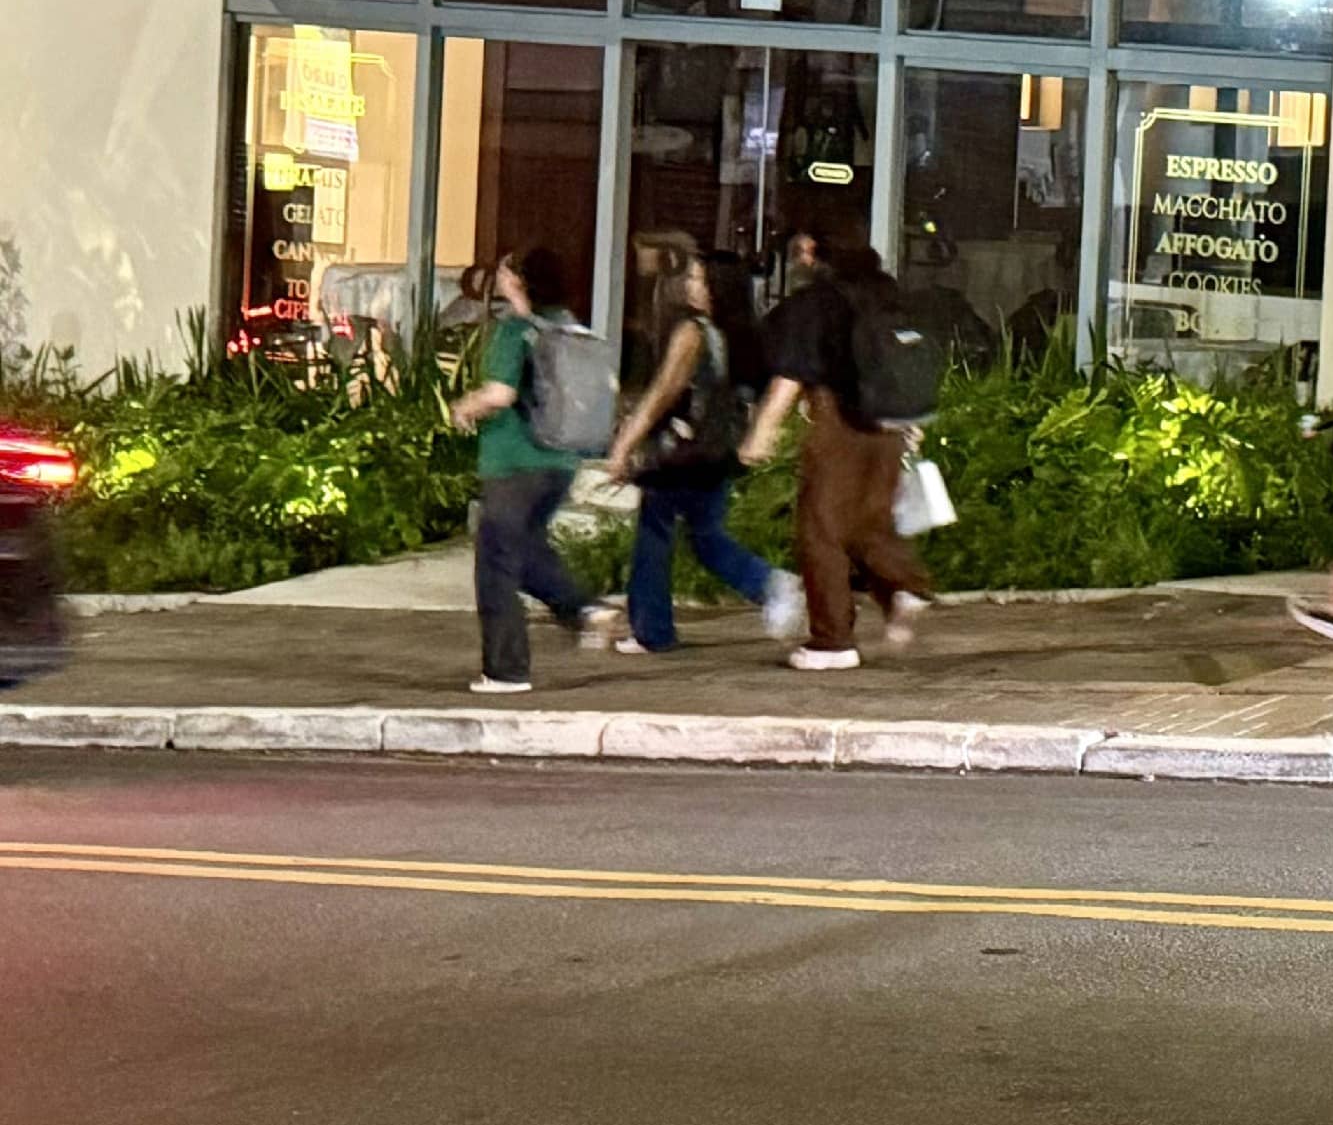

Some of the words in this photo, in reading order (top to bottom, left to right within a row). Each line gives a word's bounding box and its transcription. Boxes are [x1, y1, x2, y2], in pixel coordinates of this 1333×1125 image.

[1165, 154, 1279, 186] ESPRESSO
[1151, 192, 1287, 225] MACCHIATO
[1155, 231, 1279, 264] AFFOGATO
[1168, 270, 1263, 296] COOKIES
